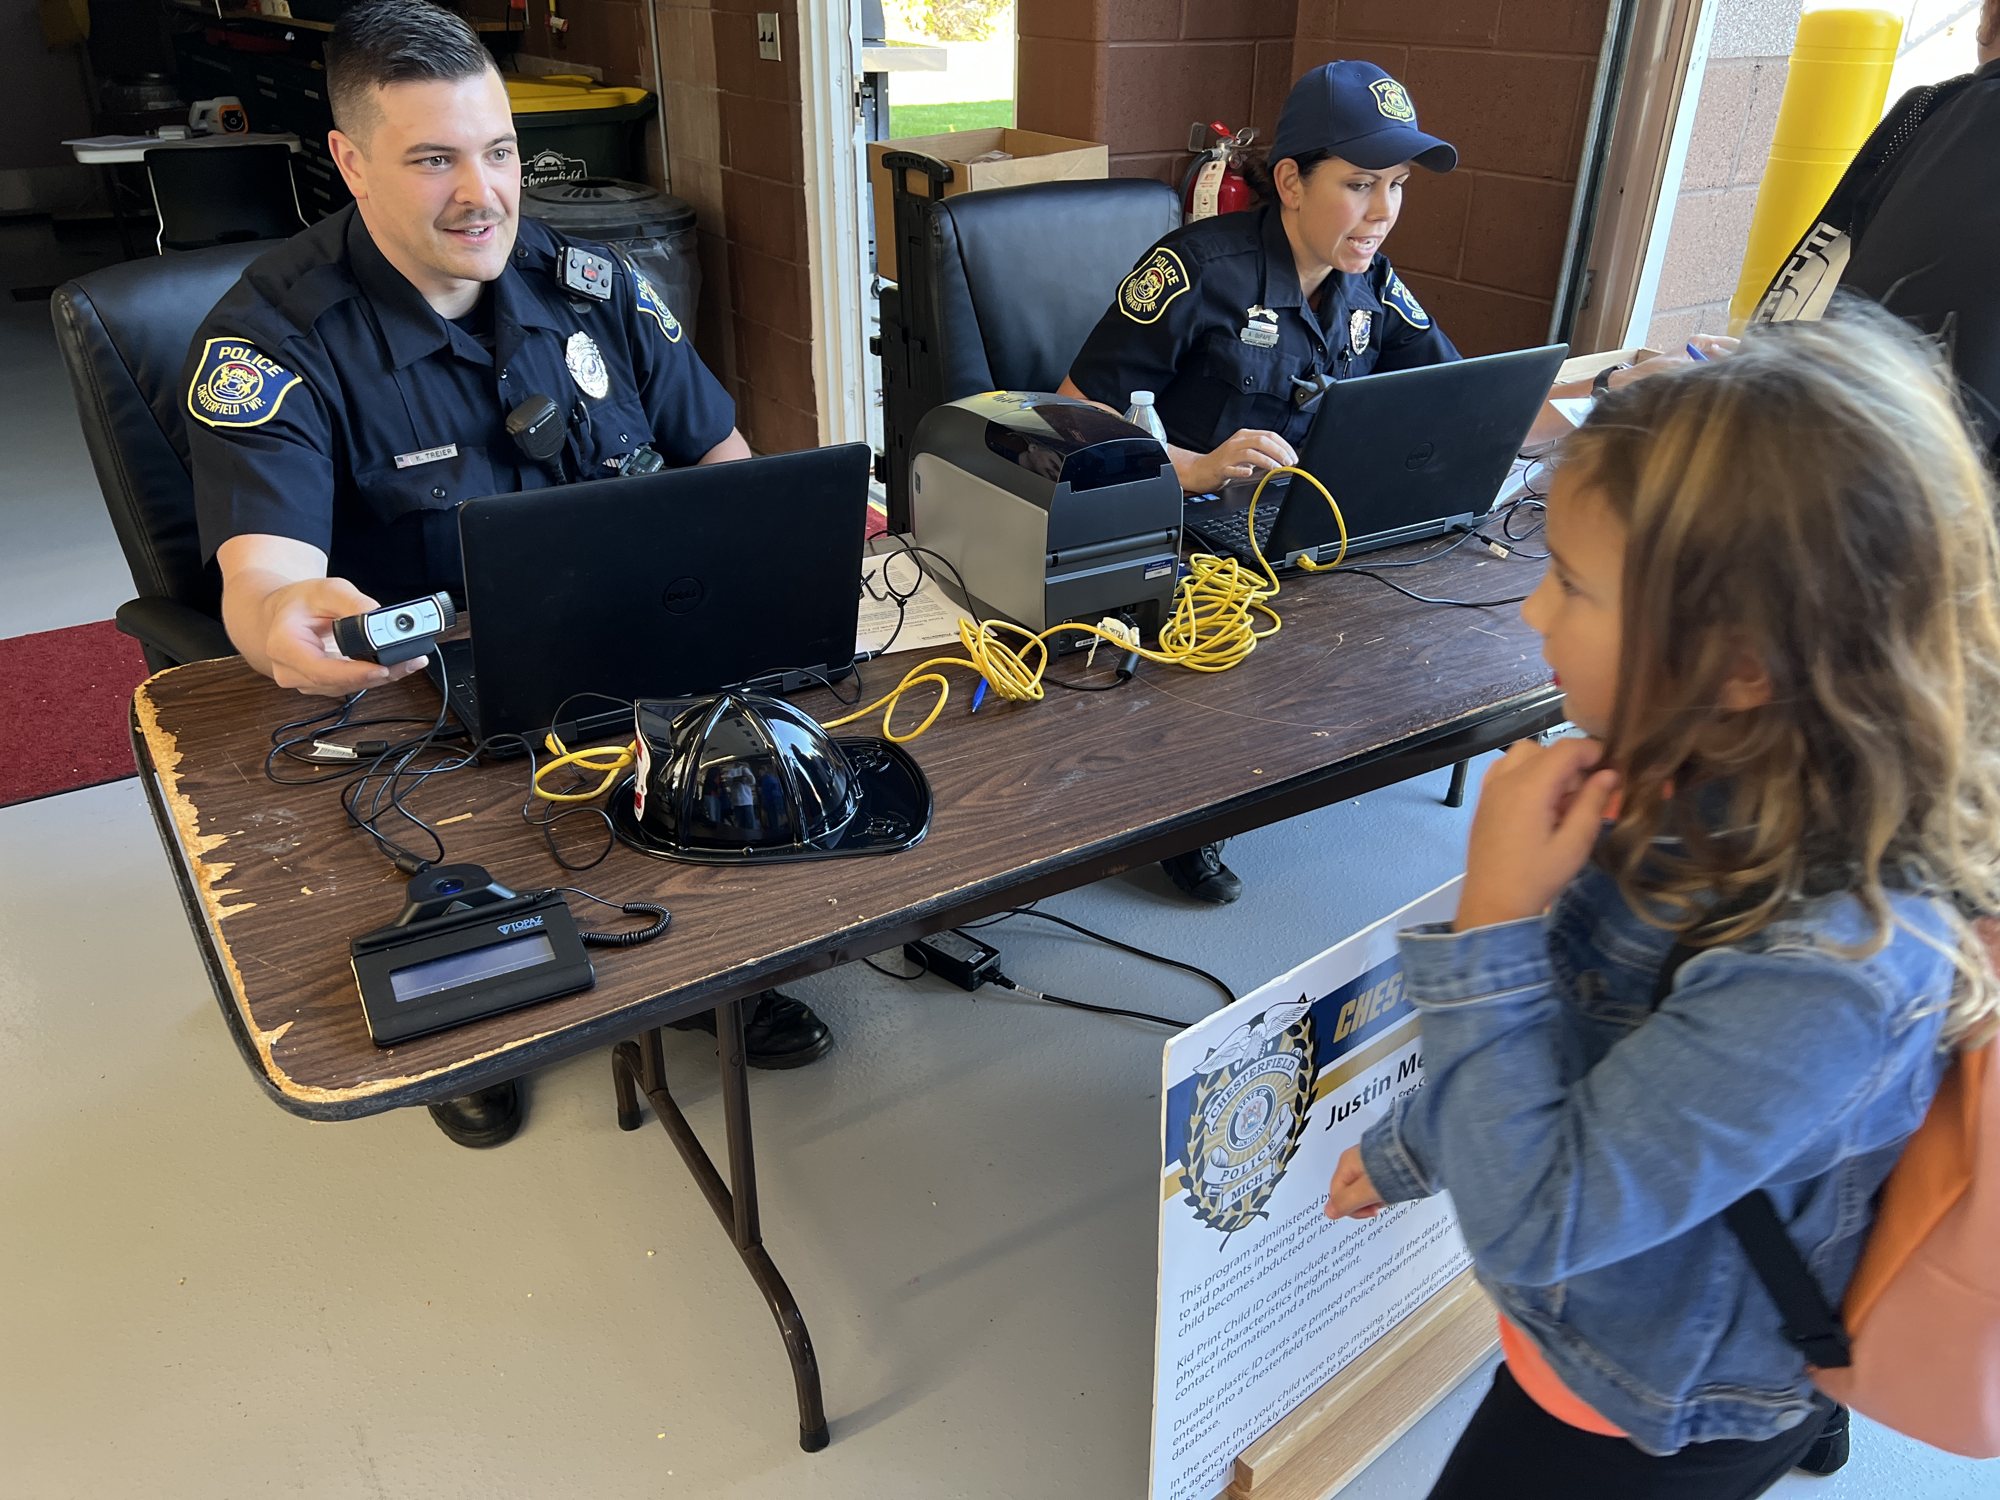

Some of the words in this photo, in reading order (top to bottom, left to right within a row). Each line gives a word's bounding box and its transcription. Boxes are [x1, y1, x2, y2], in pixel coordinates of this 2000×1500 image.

[521, 169, 583, 188] Chesterfield
[1152, 255, 1180, 287] POLICE
[1142, 301, 1158, 313] TWP.
[218, 346, 285, 378] POLICE
[197, 383, 240, 415] CHESTERFIELD
[241, 397, 267, 413] TWP.
[509, 915, 542, 930] TOPAZ
[1210, 1057, 1296, 1119] CHESTERFIELD
[1325, 1074, 1391, 1132] Justin
[1220, 1139, 1276, 1182] POLICE
[1230, 1172, 1265, 1202] MICH
[1179, 1309, 1190, 1321] to
[1192, 1291, 1209, 1311] aid
[1213, 1264, 1251, 1300] parents
[1254, 1255, 1263, 1267] in
[1267, 1233, 1294, 1258] being
[1180, 1284, 1201, 1303] This
[1205, 1250, 1250, 1290] program
[1253, 1198, 1318, 1252] administered
[1176, 1350, 1194, 1370] Kid
[1197, 1331, 1221, 1355] Print
[1224, 1307, 1250, 1333] Child
[1252, 1299, 1263, 1312] ID
[1266, 1279, 1291, 1302] cards
[1295, 1252, 1329, 1282] include
[1330, 1246, 1336, 1254] a
[1339, 1224, 1366, 1251] photo
[1176, 1346, 1218, 1388] physical
[1221, 1293, 1291, 1351] characteristics
[1367, 1226, 1383, 1240] eye
[1179, 1310, 1204, 1337] child
[1208, 1277, 1254, 1316] becomes
[1257, 1238, 1304, 1280] abducted
[1306, 1231, 1317, 1243] or
[1173, 1408, 1213, 1446] entered
[1216, 1393, 1235, 1412] into
[1237, 1387, 1243, 1395] a
[1246, 1337, 1303, 1387] Chesterfield
[1305, 1305, 1348, 1341] Township
[1350, 1284, 1375, 1307] Police
[1378, 1242, 1427, 1286] Department
[1174, 1395, 1214, 1431] Durable
[1217, 1368, 1249, 1399] plastic
[1251, 1357, 1262, 1370] ID
[1265, 1336, 1289, 1359] cards
[1291, 1324, 1307, 1339] are
[1309, 1293, 1342, 1328] printed
[1344, 1272, 1374, 1298] on-site
[1375, 1255, 1393, 1274] and
[1394, 1246, 1404, 1260] all
[1406, 1237, 1420, 1251] the
[1422, 1221, 1439, 1239] data
[1440, 1215, 1447, 1224] is
[1176, 1366, 1214, 1400] contact
[1218, 1320, 1275, 1368] information
[1277, 1301, 1296, 1322] and
[1307, 1256, 1361, 1300] thumbprint.
[1170, 1478, 1179, 1489] In
[1182, 1462, 1199, 1479] the
[1202, 1436, 1230, 1463] event
[1233, 1419, 1251, 1438] that
[1254, 1400, 1275, 1424] your
[1278, 1378, 1300, 1402] child
[1302, 1362, 1324, 1382] were
[1326, 1353, 1335, 1363] to
[1337, 1342, 1349, 1357] go
[1386, 1299, 1402, 1317] you
[1405, 1275, 1429, 1300] would
[1431, 1252, 1460, 1282] provide
[1189, 1454, 1225, 1488] agency
[1226, 1439, 1244, 1456] can
[1247, 1409, 1280, 1445] quickly
[1283, 1365, 1336, 1411] disseminate
[1338, 1347, 1357, 1371] your
[1387, 1295, 1419, 1327] detailed
[1421, 1252, 1467, 1299] information
[1172, 1420, 1220, 1460] database.
[1200, 1463, 1227, 1492] social
